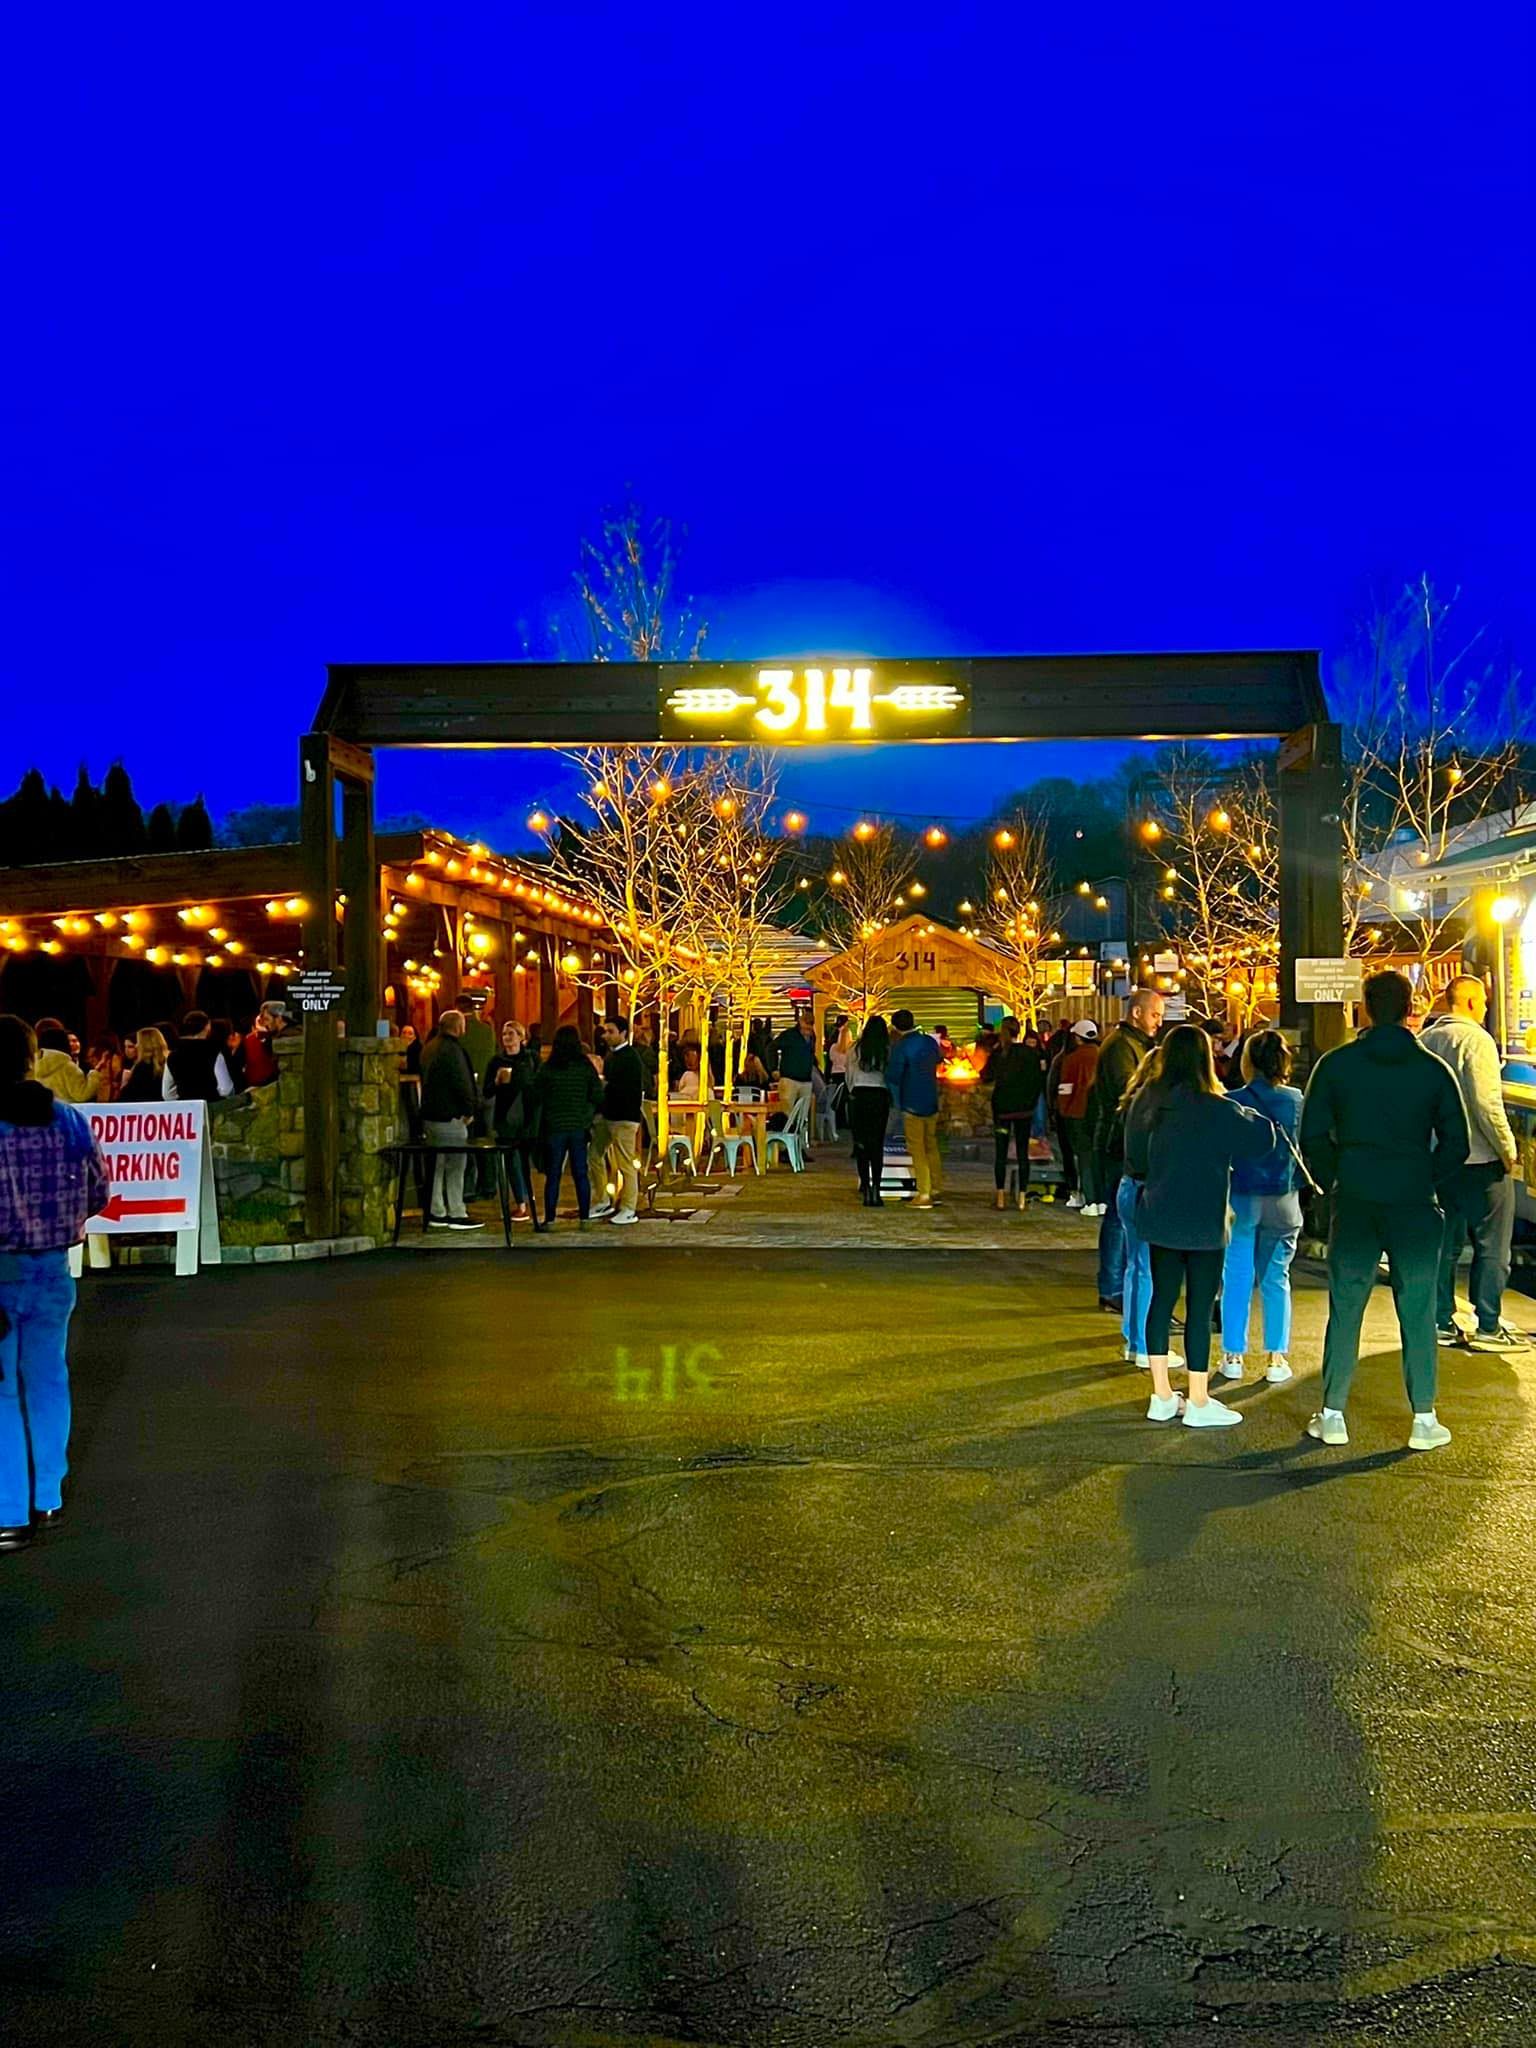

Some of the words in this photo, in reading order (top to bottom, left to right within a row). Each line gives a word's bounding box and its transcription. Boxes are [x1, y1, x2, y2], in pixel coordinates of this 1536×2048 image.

[754, 668, 872, 730] 314
[896, 951, 936, 971] 314
[302, 999, 330, 1011] ONLY
[1314, 989, 1344, 1001] ONLY
[91, 1113, 197, 1143] DDITIONAL
[103, 1152, 180, 1183] ARKING
